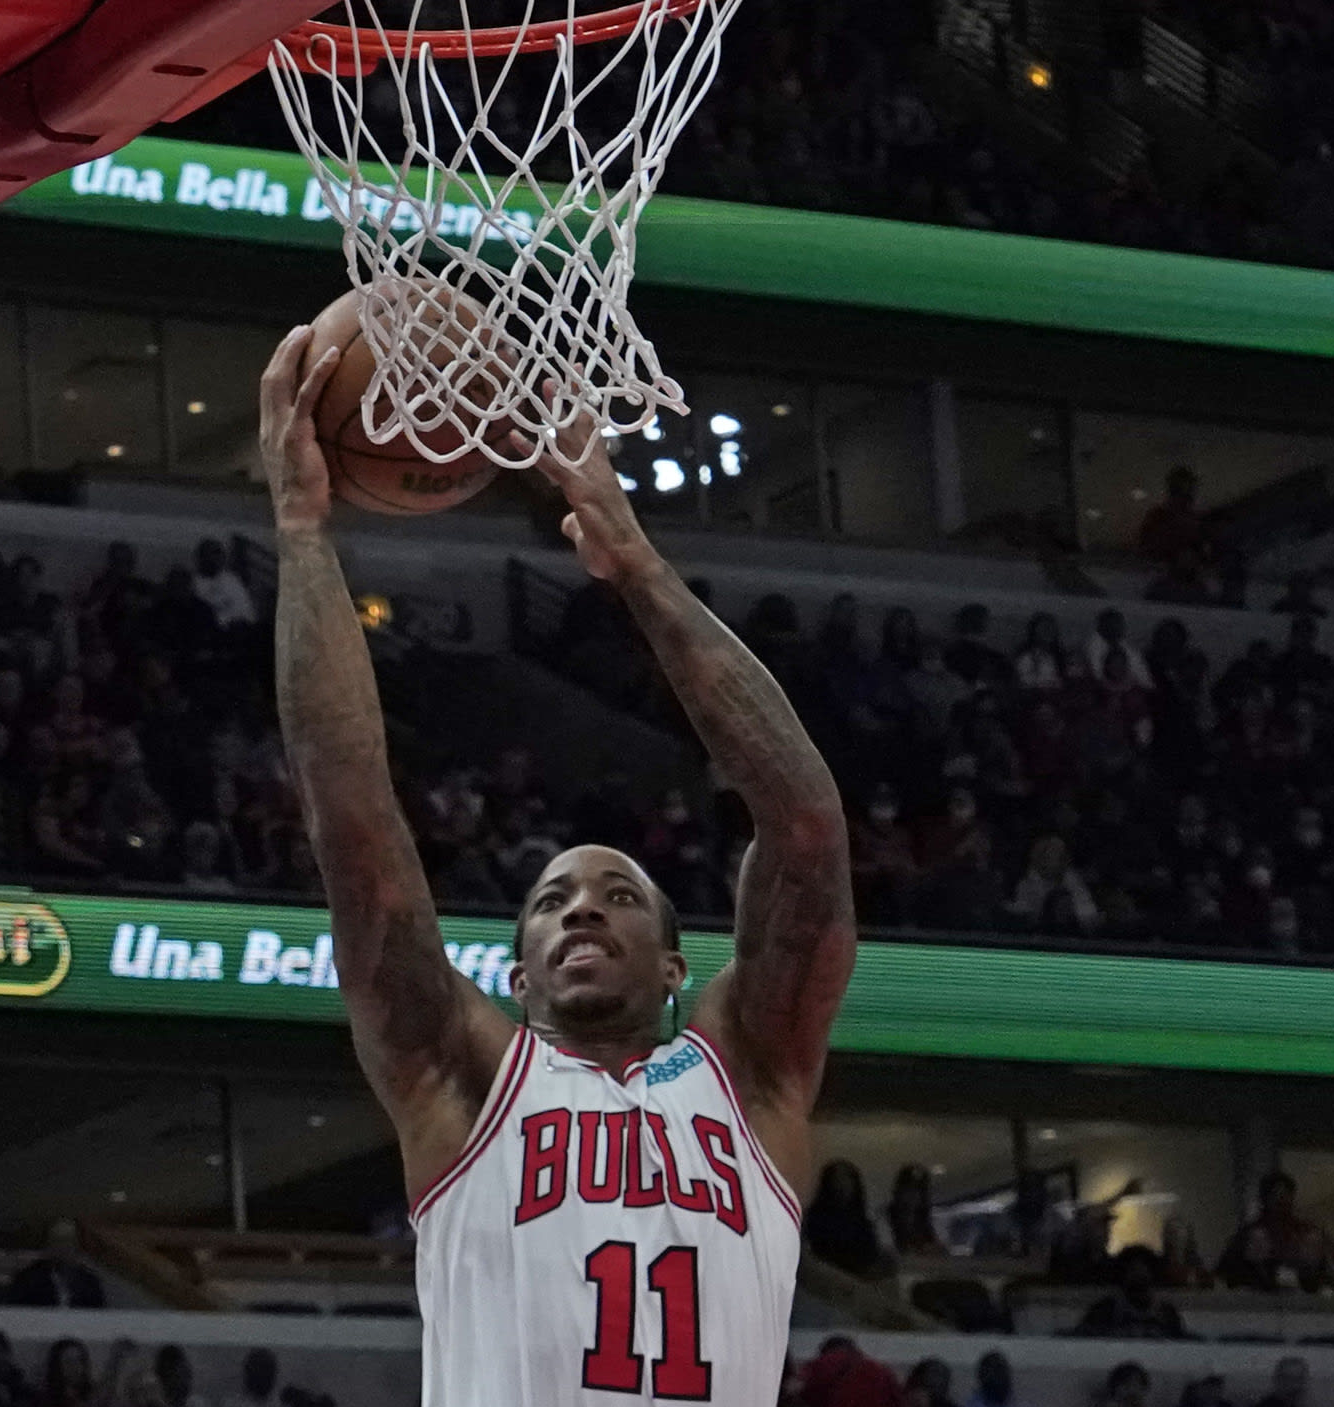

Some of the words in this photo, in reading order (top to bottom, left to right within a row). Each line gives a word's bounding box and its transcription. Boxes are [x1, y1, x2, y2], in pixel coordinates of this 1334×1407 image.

[71, 153, 164, 203] Una
[176, 160, 289, 217] Bella
[109, 921, 224, 982] Una
[237, 927, 339, 989] Bel
[514, 1105, 749, 1237] BULLS
[581, 1239, 712, 1403] 11
